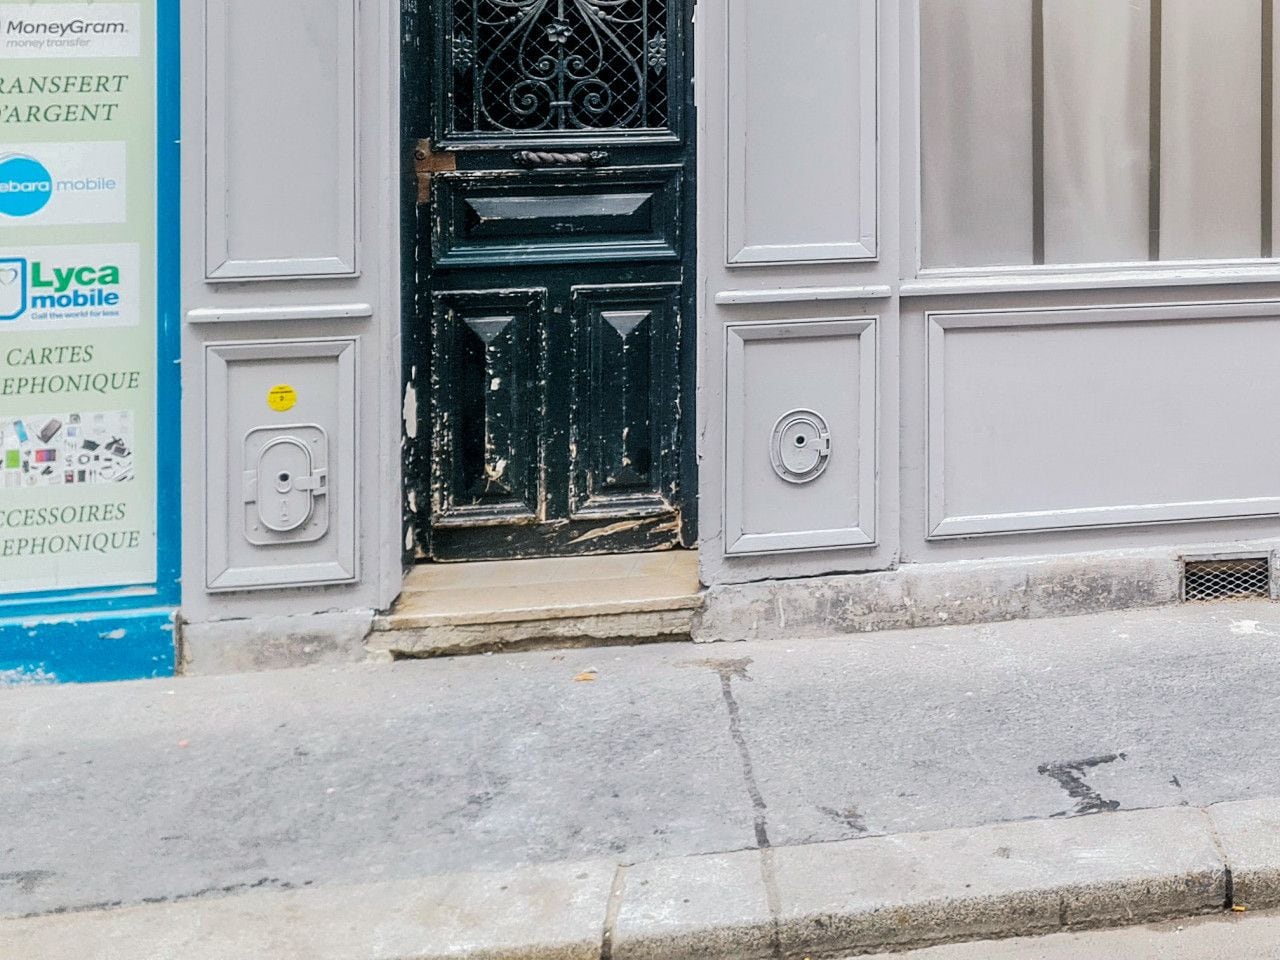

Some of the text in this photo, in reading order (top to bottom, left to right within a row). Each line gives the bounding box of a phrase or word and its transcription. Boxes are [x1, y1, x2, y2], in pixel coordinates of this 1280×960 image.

[7, 20, 125, 37] MoneyGram
[6, 37, 91, 49] money transfer
[0, 104, 118, 123] 'ARGENT
[57, 177, 116, 190] mobile
[31, 262, 119, 292] Lyca
[31, 288, 119, 308] mobile
[6, 345, 94, 367] CARTES
[2, 371, 140, 395] EPHONIQUE
[2, 530, 141, 557] EPHONIQUE
